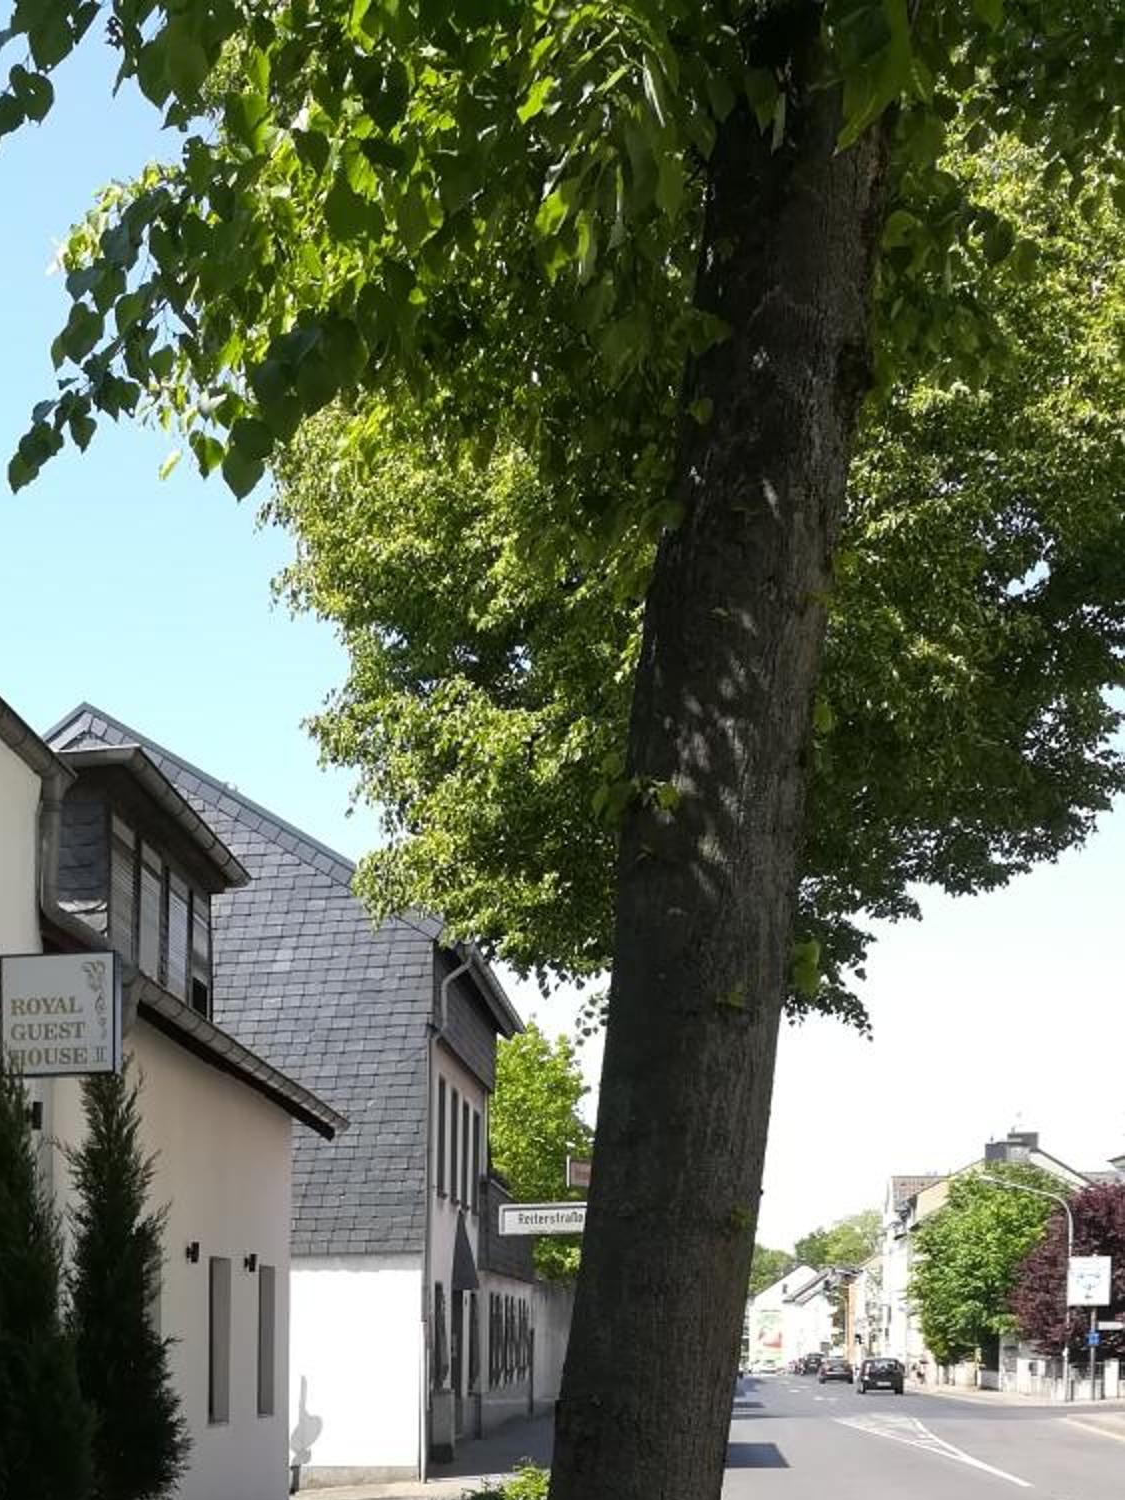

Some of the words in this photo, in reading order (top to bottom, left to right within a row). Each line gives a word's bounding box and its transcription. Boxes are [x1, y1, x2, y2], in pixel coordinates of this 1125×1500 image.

[9, 996, 84, 1017] ROYAL
[10, 1021, 86, 1041] GUEST
[8, 1047, 89, 1067] HOUSE
